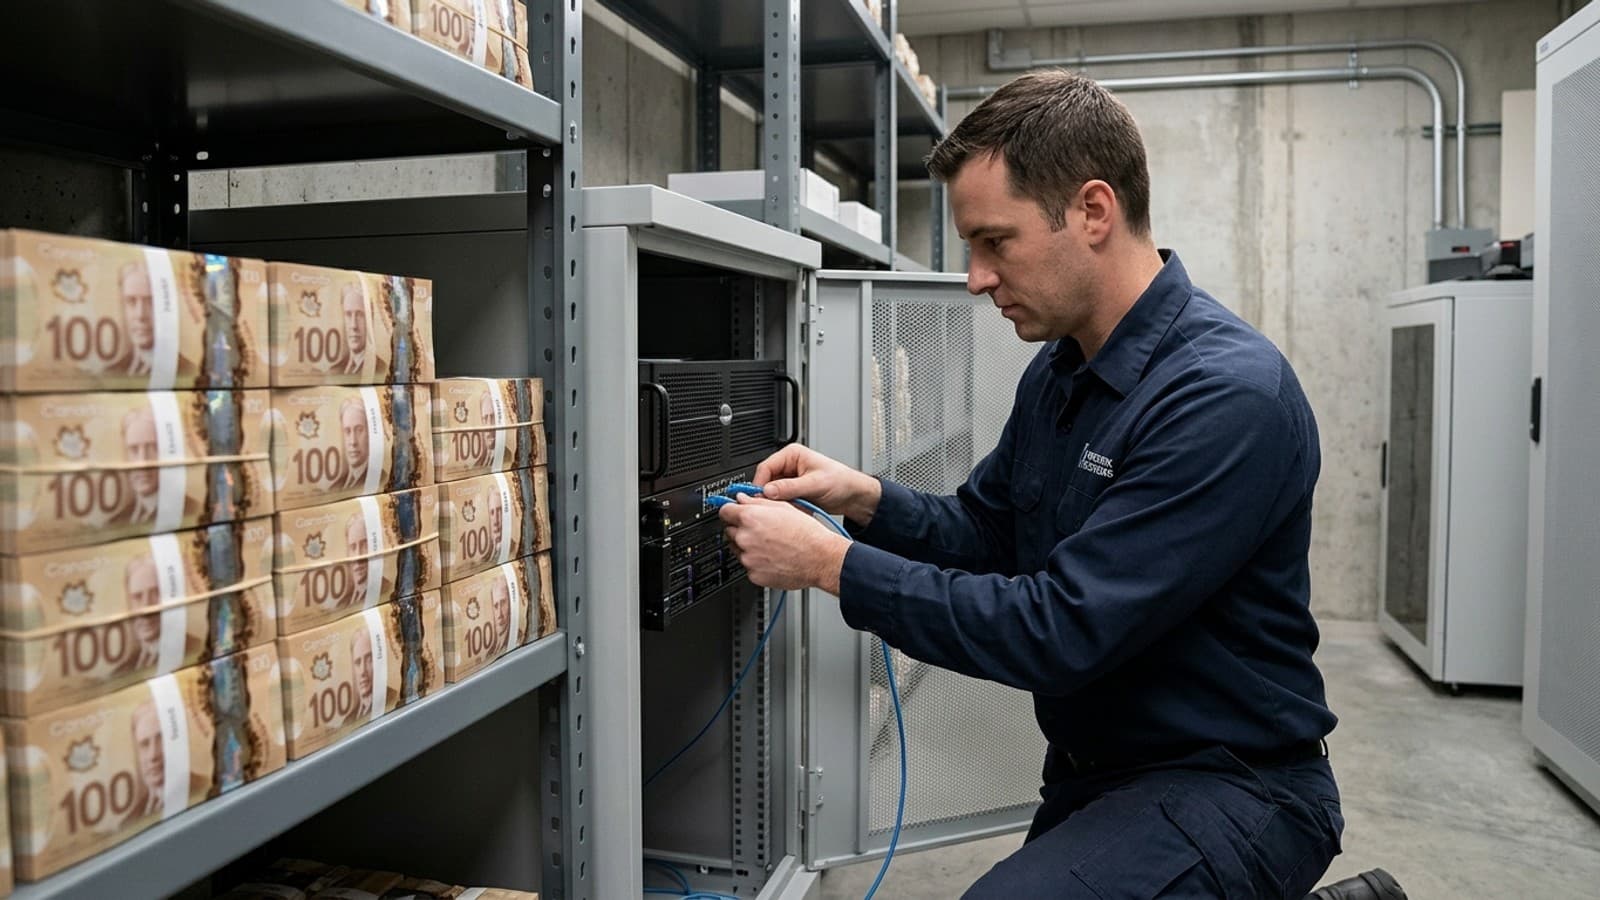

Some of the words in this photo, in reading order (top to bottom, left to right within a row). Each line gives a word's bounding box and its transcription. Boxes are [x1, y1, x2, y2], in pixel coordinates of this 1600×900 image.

[431, 3, 462, 42] 100
[46, 315, 120, 361] 100
[294, 327, 341, 363] 100
[292, 446, 341, 484] 100
[452, 431, 481, 461] 100
[48, 469, 123, 519] 100
[460, 526, 488, 560] 100
[300, 564, 346, 607] 100
[54, 622, 126, 677] 100
[465, 621, 493, 658] 100
[308, 681, 353, 728] 100
[60, 771, 134, 835] 100
